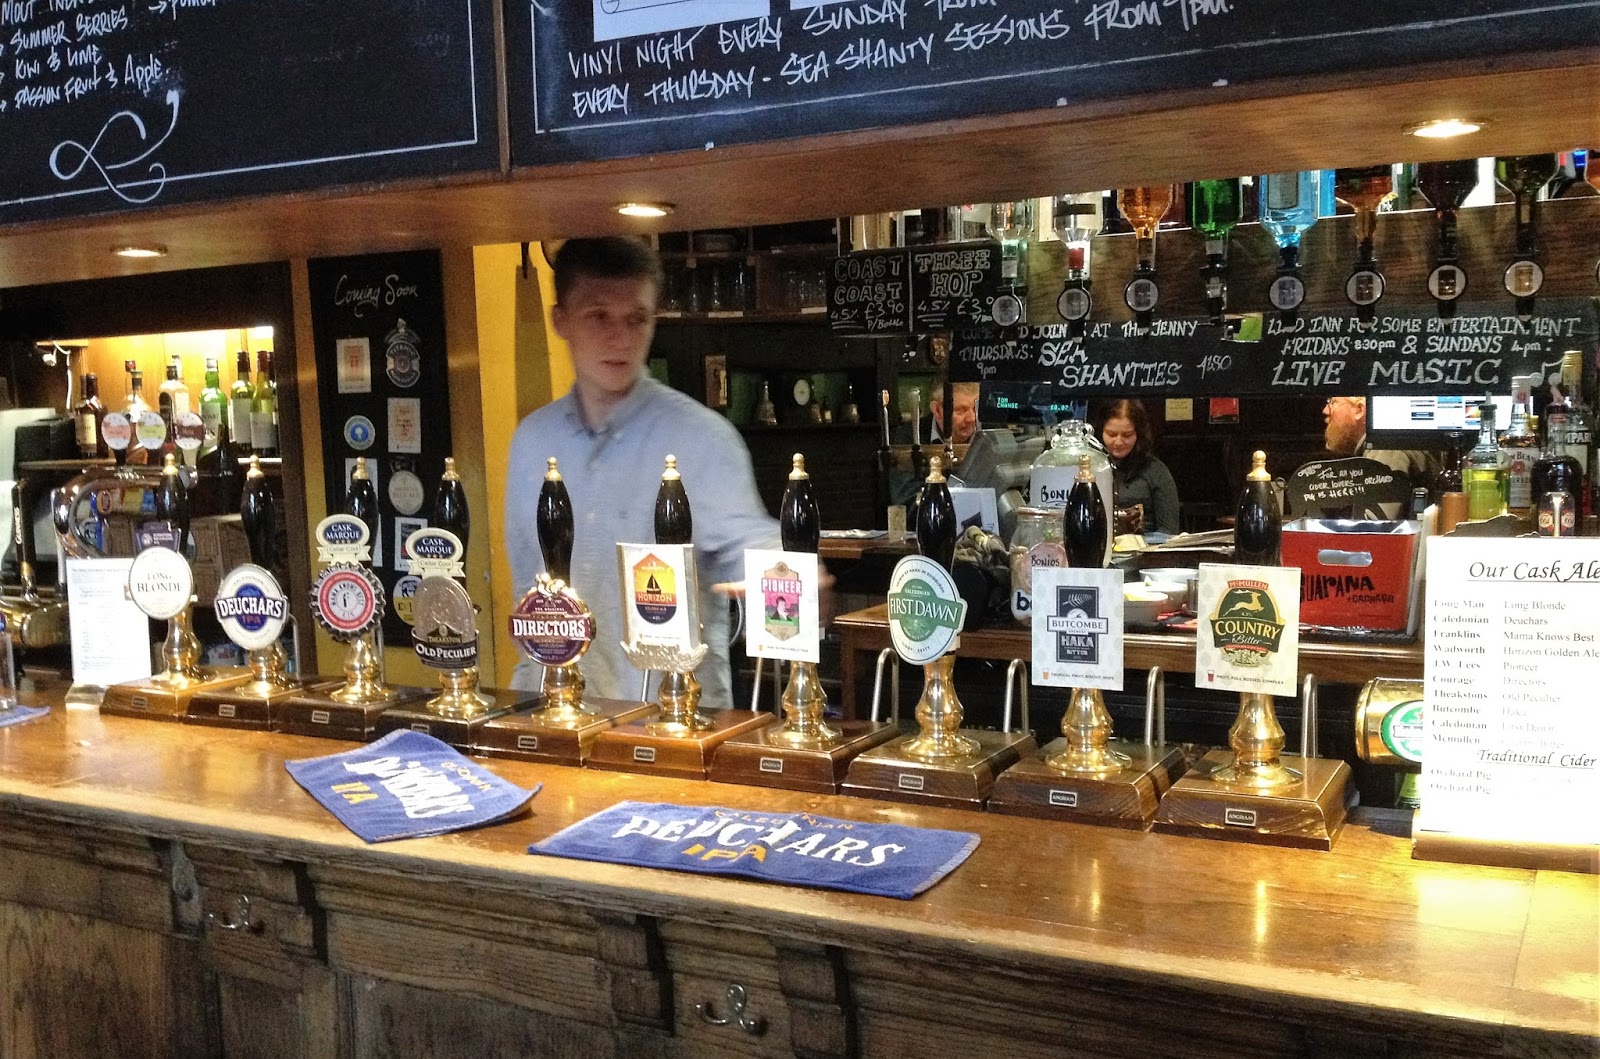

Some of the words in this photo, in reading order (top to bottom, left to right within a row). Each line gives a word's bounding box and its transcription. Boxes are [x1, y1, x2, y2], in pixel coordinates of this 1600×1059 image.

[10, 20, 71, 55] SUMMER
[75, 5, 128, 41] BERRIES
[636, 25, 707, 70] NIGHT
[718, 17, 782, 54] EVERY
[802, 0, 909, 36] SUNDAY
[572, 82, 630, 118] EVERY
[644, 66, 755, 106] THURSDAY
[779, 51, 829, 85] SEA
[836, 33, 934, 70] SHANTY
[944, 9, 1071, 51] SESSIONS
[1084, 1, 1162, 41] FROM
[15, 59, 40, 80] KIWI
[14, 85, 60, 109] PASSION
[834, 255, 904, 283] COAST
[914, 249, 991, 274] THREE
[930, 270, 983, 298] HOP
[334, 274, 381, 318] Coming
[385, 273, 419, 305] Soon
[834, 282, 903, 305] COAST
[864, 299, 905, 320] £3.90
[1032, 323, 1068, 339] JOIN
[1091, 322, 1111, 338] AT
[1151, 319, 1199, 337] JENNY
[1308, 316, 1344, 334] INN
[1380, 316, 1422, 334] SOME
[1280, 336, 1351, 356] FRIDAYS
[1354, 338, 1396, 353] 8:30pm
[1401, 335, 1418, 354] &
[1425, 335, 1503, 354] SUNDAYS
[976, 361, 997, 379] 9pm
[1059, 361, 1183, 389] SHANTIES
[1271, 359, 1347, 387] LIVE
[1367, 357, 1503, 387] MUSIC
[1349, 468, 1364, 478] YOU
[1364, 475, 1394, 485] ORCHARD
[1040, 485, 1069, 503] BONI
[1328, 486, 1366, 499] HERE!!!
[326, 531, 360, 540] MARQUE
[331, 523, 352, 531] CASK
[416, 545, 453, 554] MARQUE
[422, 537, 444, 546] CASK
[1469, 561, 1508, 578] Our
[1513, 560, 1562, 583] Cask
[1564, 560, 1600, 583] Ale
[762, 578, 802, 595] PIONEER
[637, 593, 673, 603] HORIZON
[1504, 600, 1529, 611] Long
[1532, 601, 1566, 611] Blonde
[217, 596, 283, 618] DEUCHARS
[890, 597, 914, 615] FIRST
[914, 600, 958, 623] DAWN
[512, 618, 586, 638] DIRECTORS
[1052, 620, 1104, 630] BUTCOMBE
[1433, 615, 1490, 624] Caledonian
[1503, 615, 1549, 625] Deuchars
[1215, 620, 1281, 640] COUNTRY
[1232, 632, 1262, 645] Bitter
[1433, 630, 1482, 639] Franklins
[1503, 631, 1534, 640] Mama
[1536, 632, 1571, 642] Knows
[1573, 632, 1595, 642] Best
[1061, 635, 1094, 648] HAKA
[1433, 644, 1486, 654] Wadworth
[415, 643, 436, 657] OLD
[436, 645, 477, 659] PECULIER
[1503, 646, 1542, 656] Horizon
[1544, 647, 1580, 657] Golden
[1582, 649, 1600, 658] Ale
[1503, 661, 1539, 672] Pioneer
[1432, 674, 1475, 685] Courage
[1433, 689, 1488, 699] Theakstons
[1432, 704, 1481, 714] Butcombe
[1431, 719, 1487, 729] Caledonian
[1476, 749, 1552, 765] Traditional
[1560, 753, 1597, 767] Cider
[1228, 813, 1253, 821] ANGRAM
[611, 814, 907, 867] DEUCHARS
[681, 842, 767, 864] IPA
